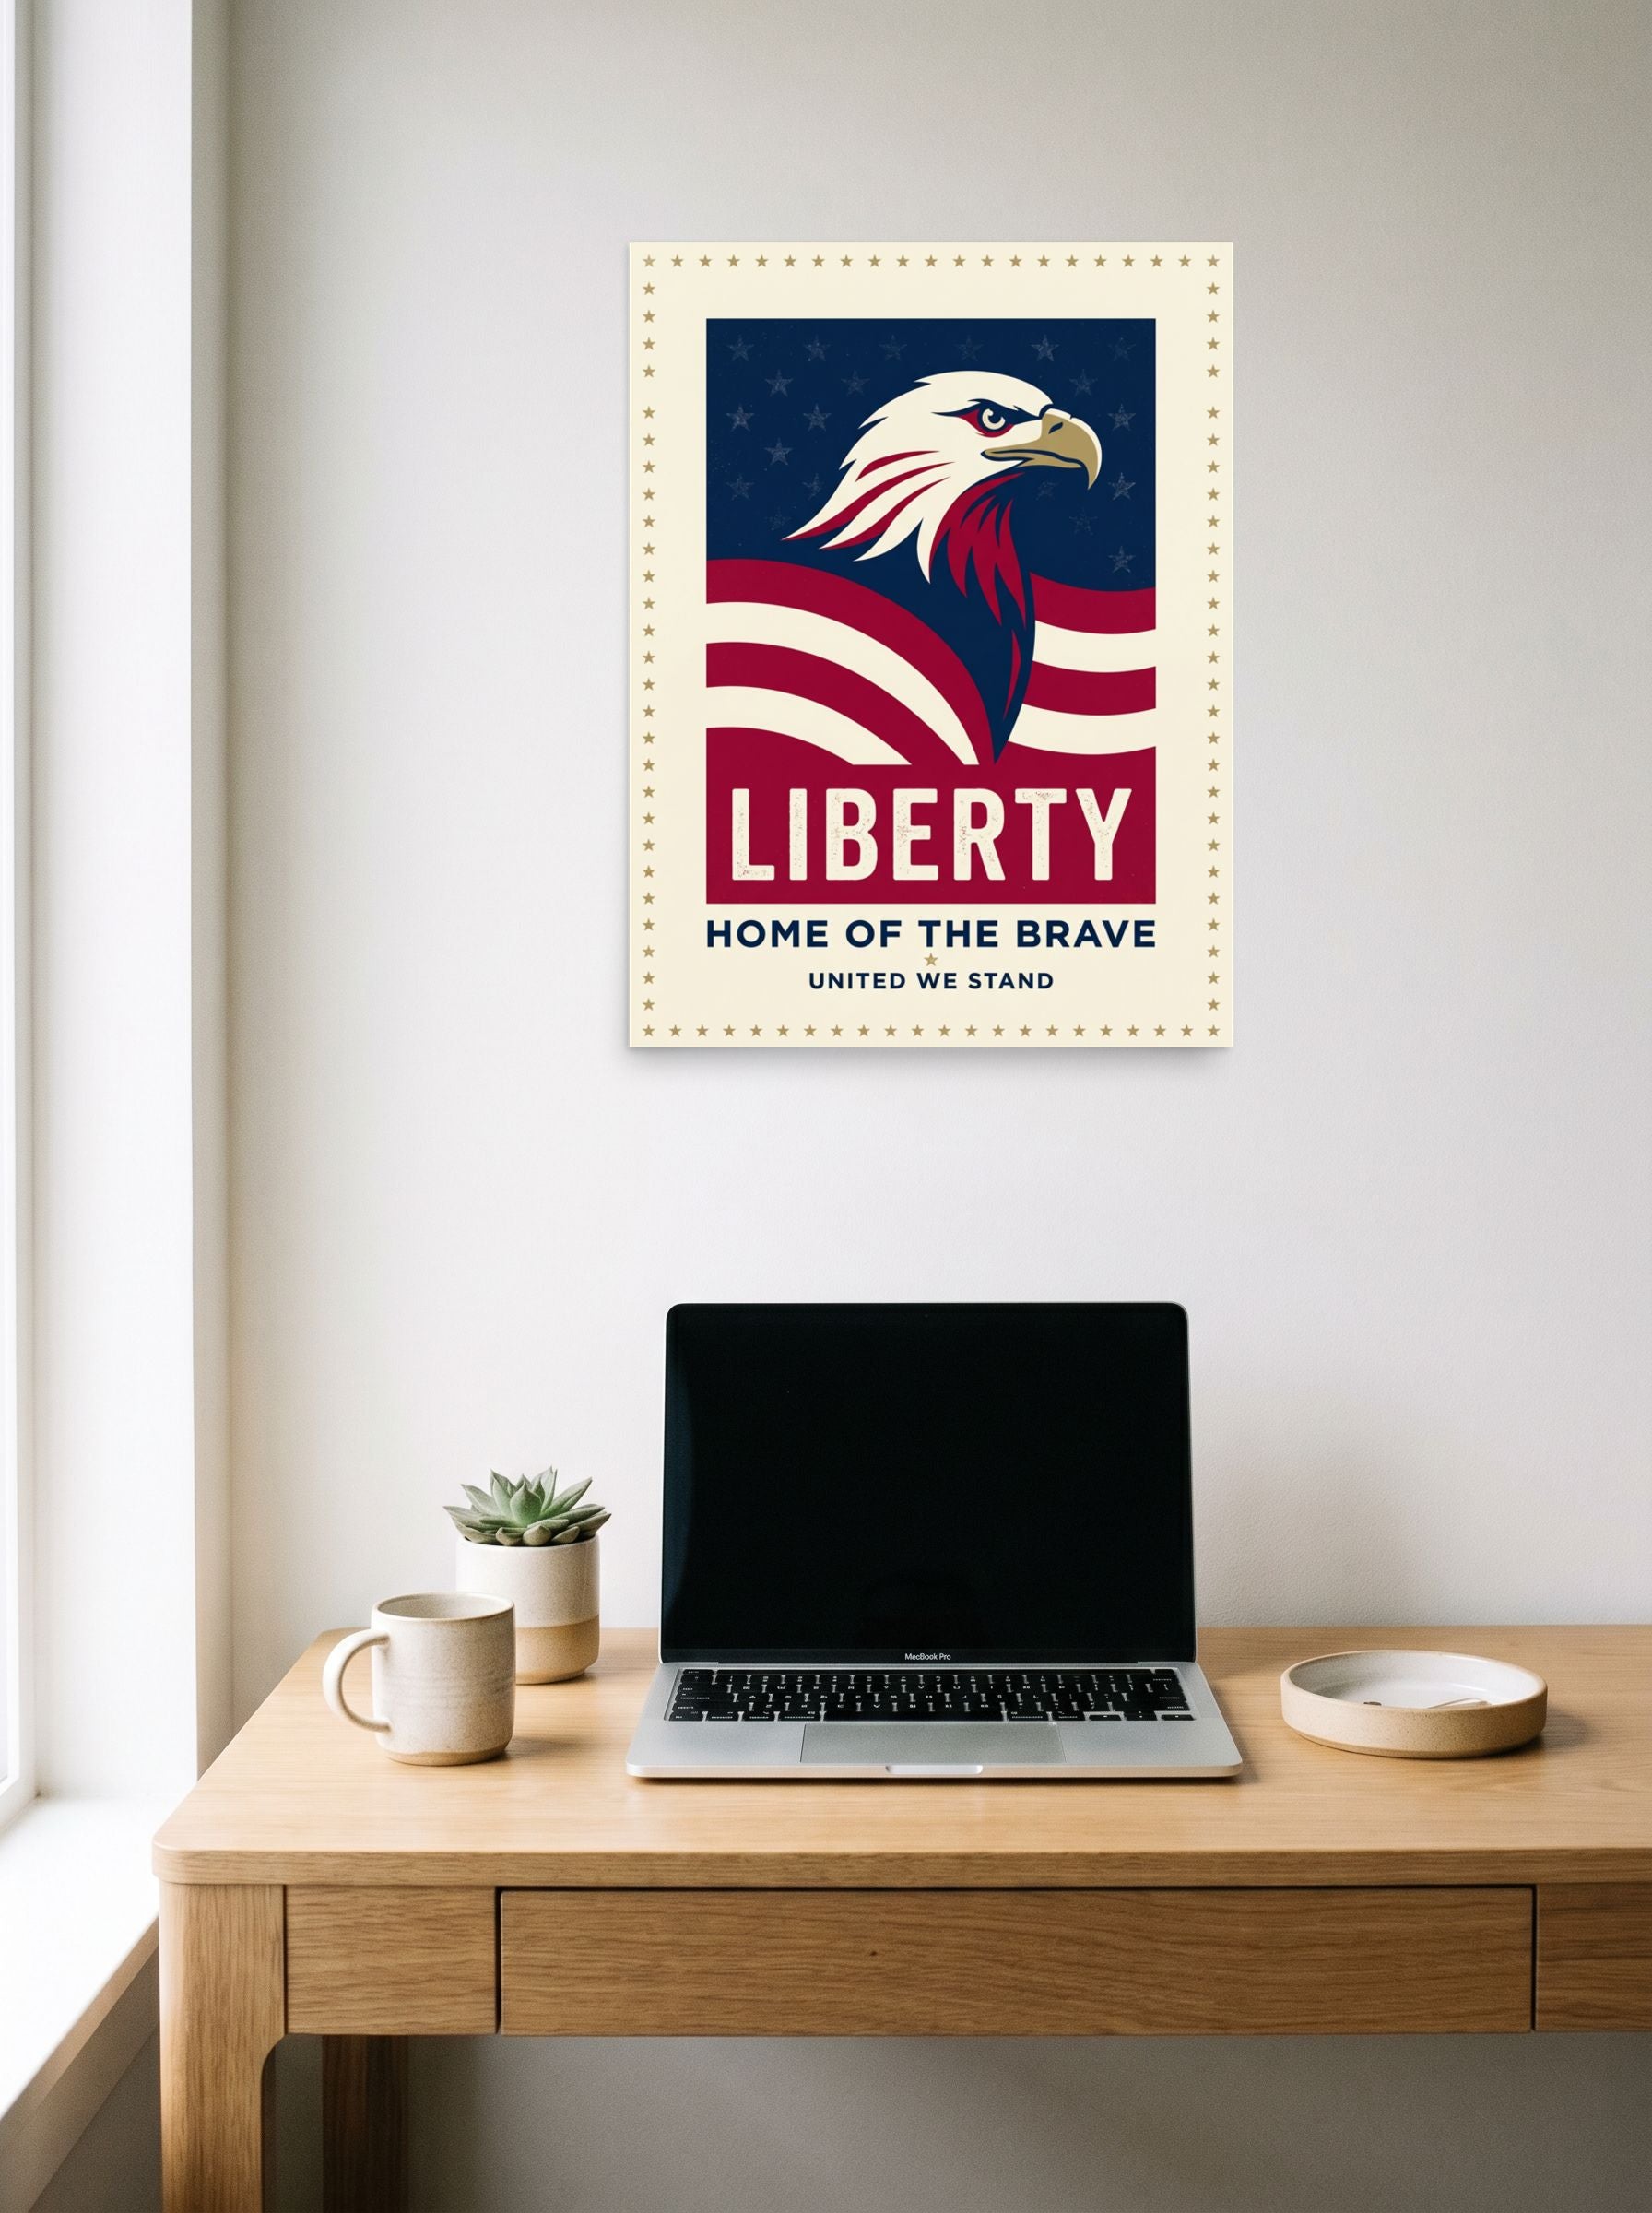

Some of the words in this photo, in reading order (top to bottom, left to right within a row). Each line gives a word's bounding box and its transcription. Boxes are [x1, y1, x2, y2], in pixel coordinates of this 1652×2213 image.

[731, 787, 1133, 881] LIBERTY
[707, 920, 828, 948] HOME
[845, 920, 902, 948] OF
[918, 920, 998, 948] THE
[1017, 920, 1156, 948] BRAVE
[809, 973, 906, 989] UNITED
[916, 973, 957, 989] WE
[968, 973, 1054, 989] STAND
[938, 1652, 951, 1661] Pro
